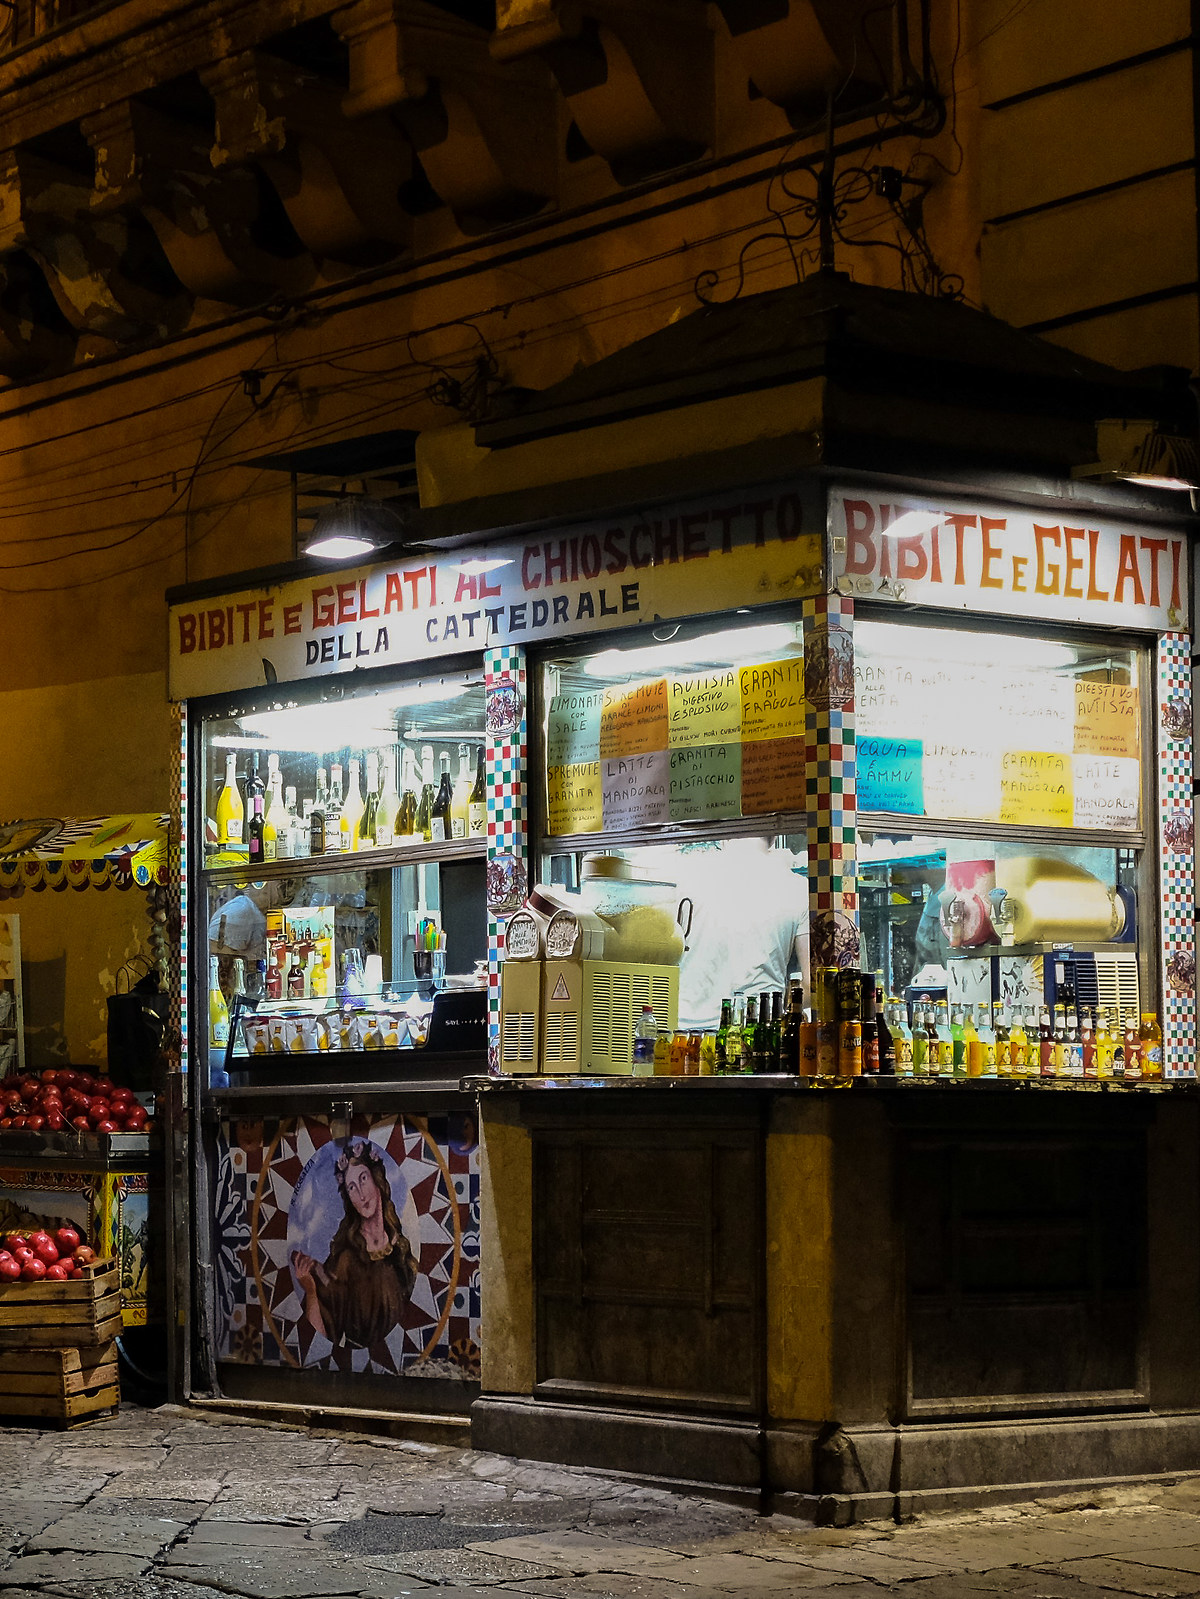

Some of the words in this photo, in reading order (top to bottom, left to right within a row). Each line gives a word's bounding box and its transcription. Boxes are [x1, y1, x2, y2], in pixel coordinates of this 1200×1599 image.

[843, 499, 1007, 590] BIBITE
[1033, 523, 1182, 610] GELATI
[178, 598, 275, 655] BIBITE
[313, 564, 437, 629] GELATI
[454, 548, 501, 601] AL
[521, 495, 802, 592] CHIOSCHETTO
[305, 627, 389, 667] DELLA
[426, 583, 641, 644] CATTEDRALE
[741, 662, 805, 696] GRANIT
[683, 692, 723, 706] DIGESTIVO
[766, 689, 776, 698] DI
[856, 693, 898, 707] ENTA
[1076, 683, 1133, 698] DIGESTIVO
[550, 694, 603, 714] LIMONATA
[673, 702, 729, 722] ESPLOSIVO
[743, 694, 805, 718] FRAGOLE
[556, 720, 588, 736] SALE
[670, 747, 726, 769] GRANITA
[856, 740, 906, 758] CQUA
[548, 762, 599, 782] SPREMUTE
[607, 755, 654, 777] LATTE
[693, 763, 703, 771] DI
[1003, 753, 1063, 771] GRANITA
[628, 776, 637, 784] DI
[670, 774, 735, 794] PISTACCHIO
[549, 788, 593, 804] GRANITA
[603, 785, 665, 805] MANDORLA
